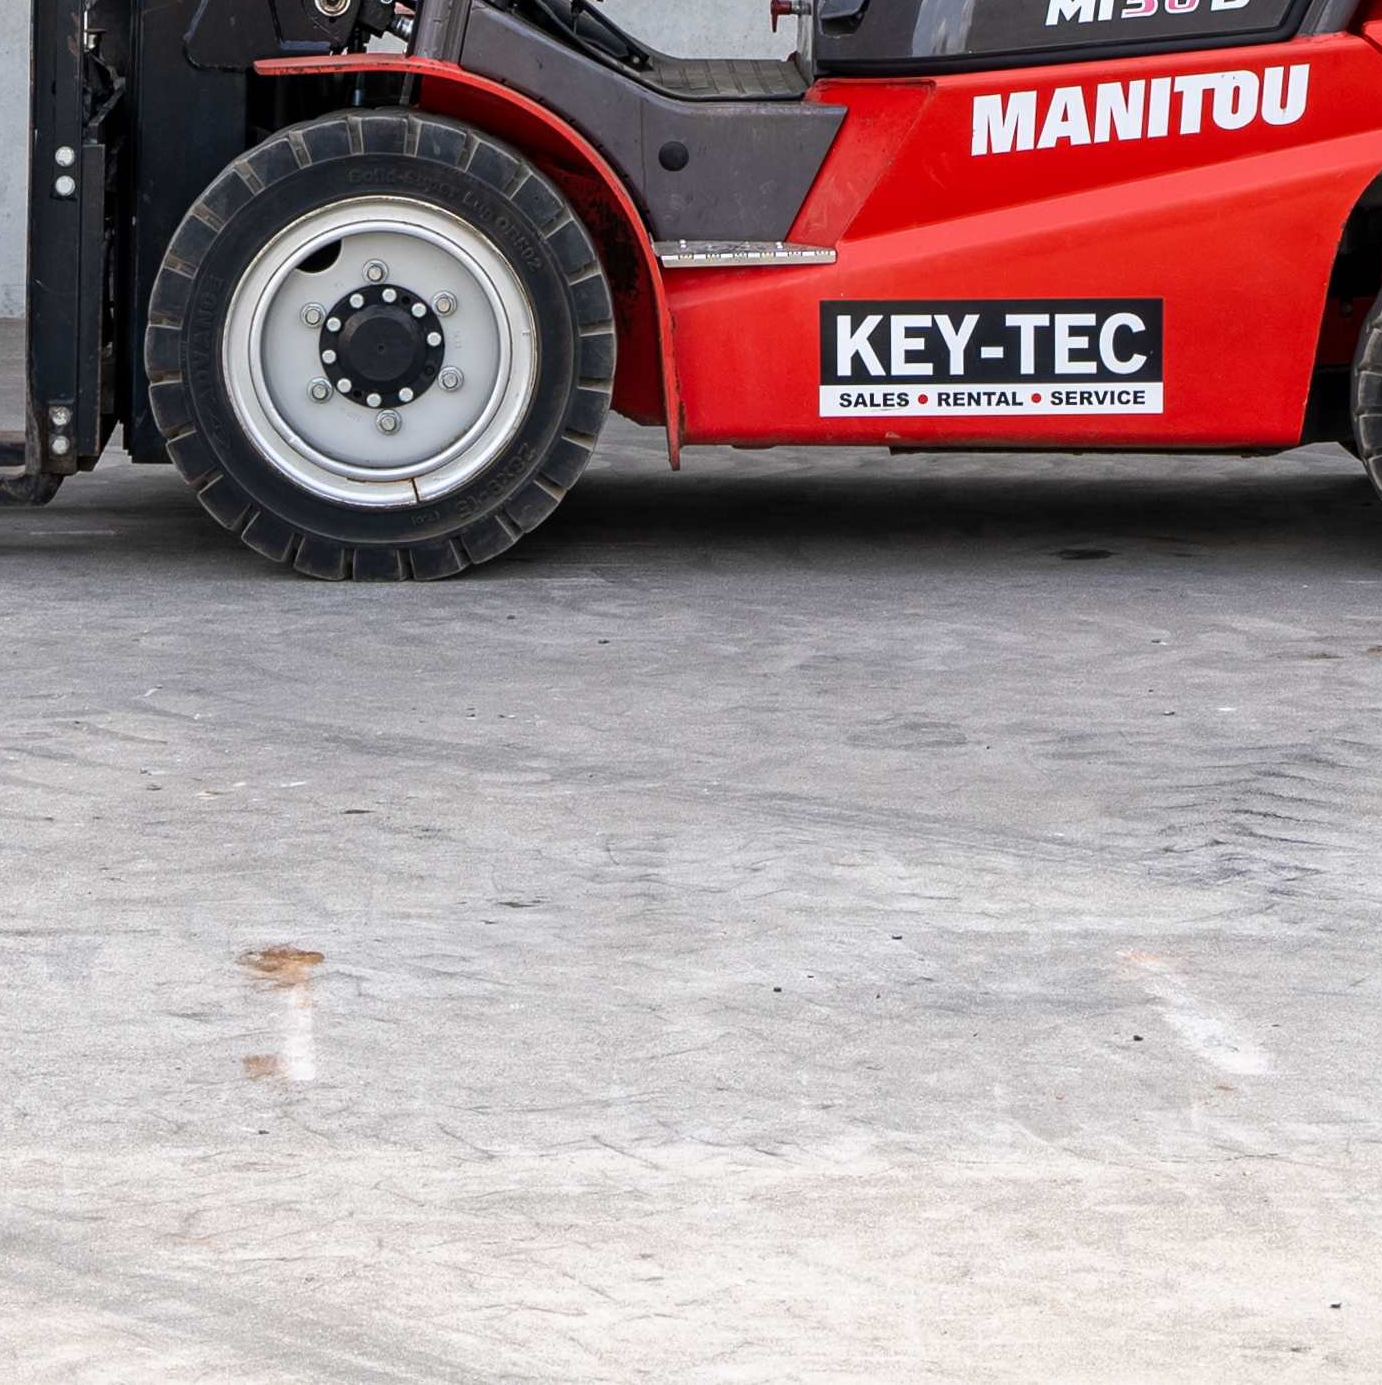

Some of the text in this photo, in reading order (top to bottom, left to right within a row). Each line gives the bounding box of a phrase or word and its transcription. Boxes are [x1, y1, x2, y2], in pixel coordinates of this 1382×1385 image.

[971, 63, 1310, 156] MANITOU
[190, 273, 225, 404] ADVANCE
[836, 312, 1147, 377] KEY-TEC
[839, 389, 1147, 409] SALES RENTAL SERVICE
